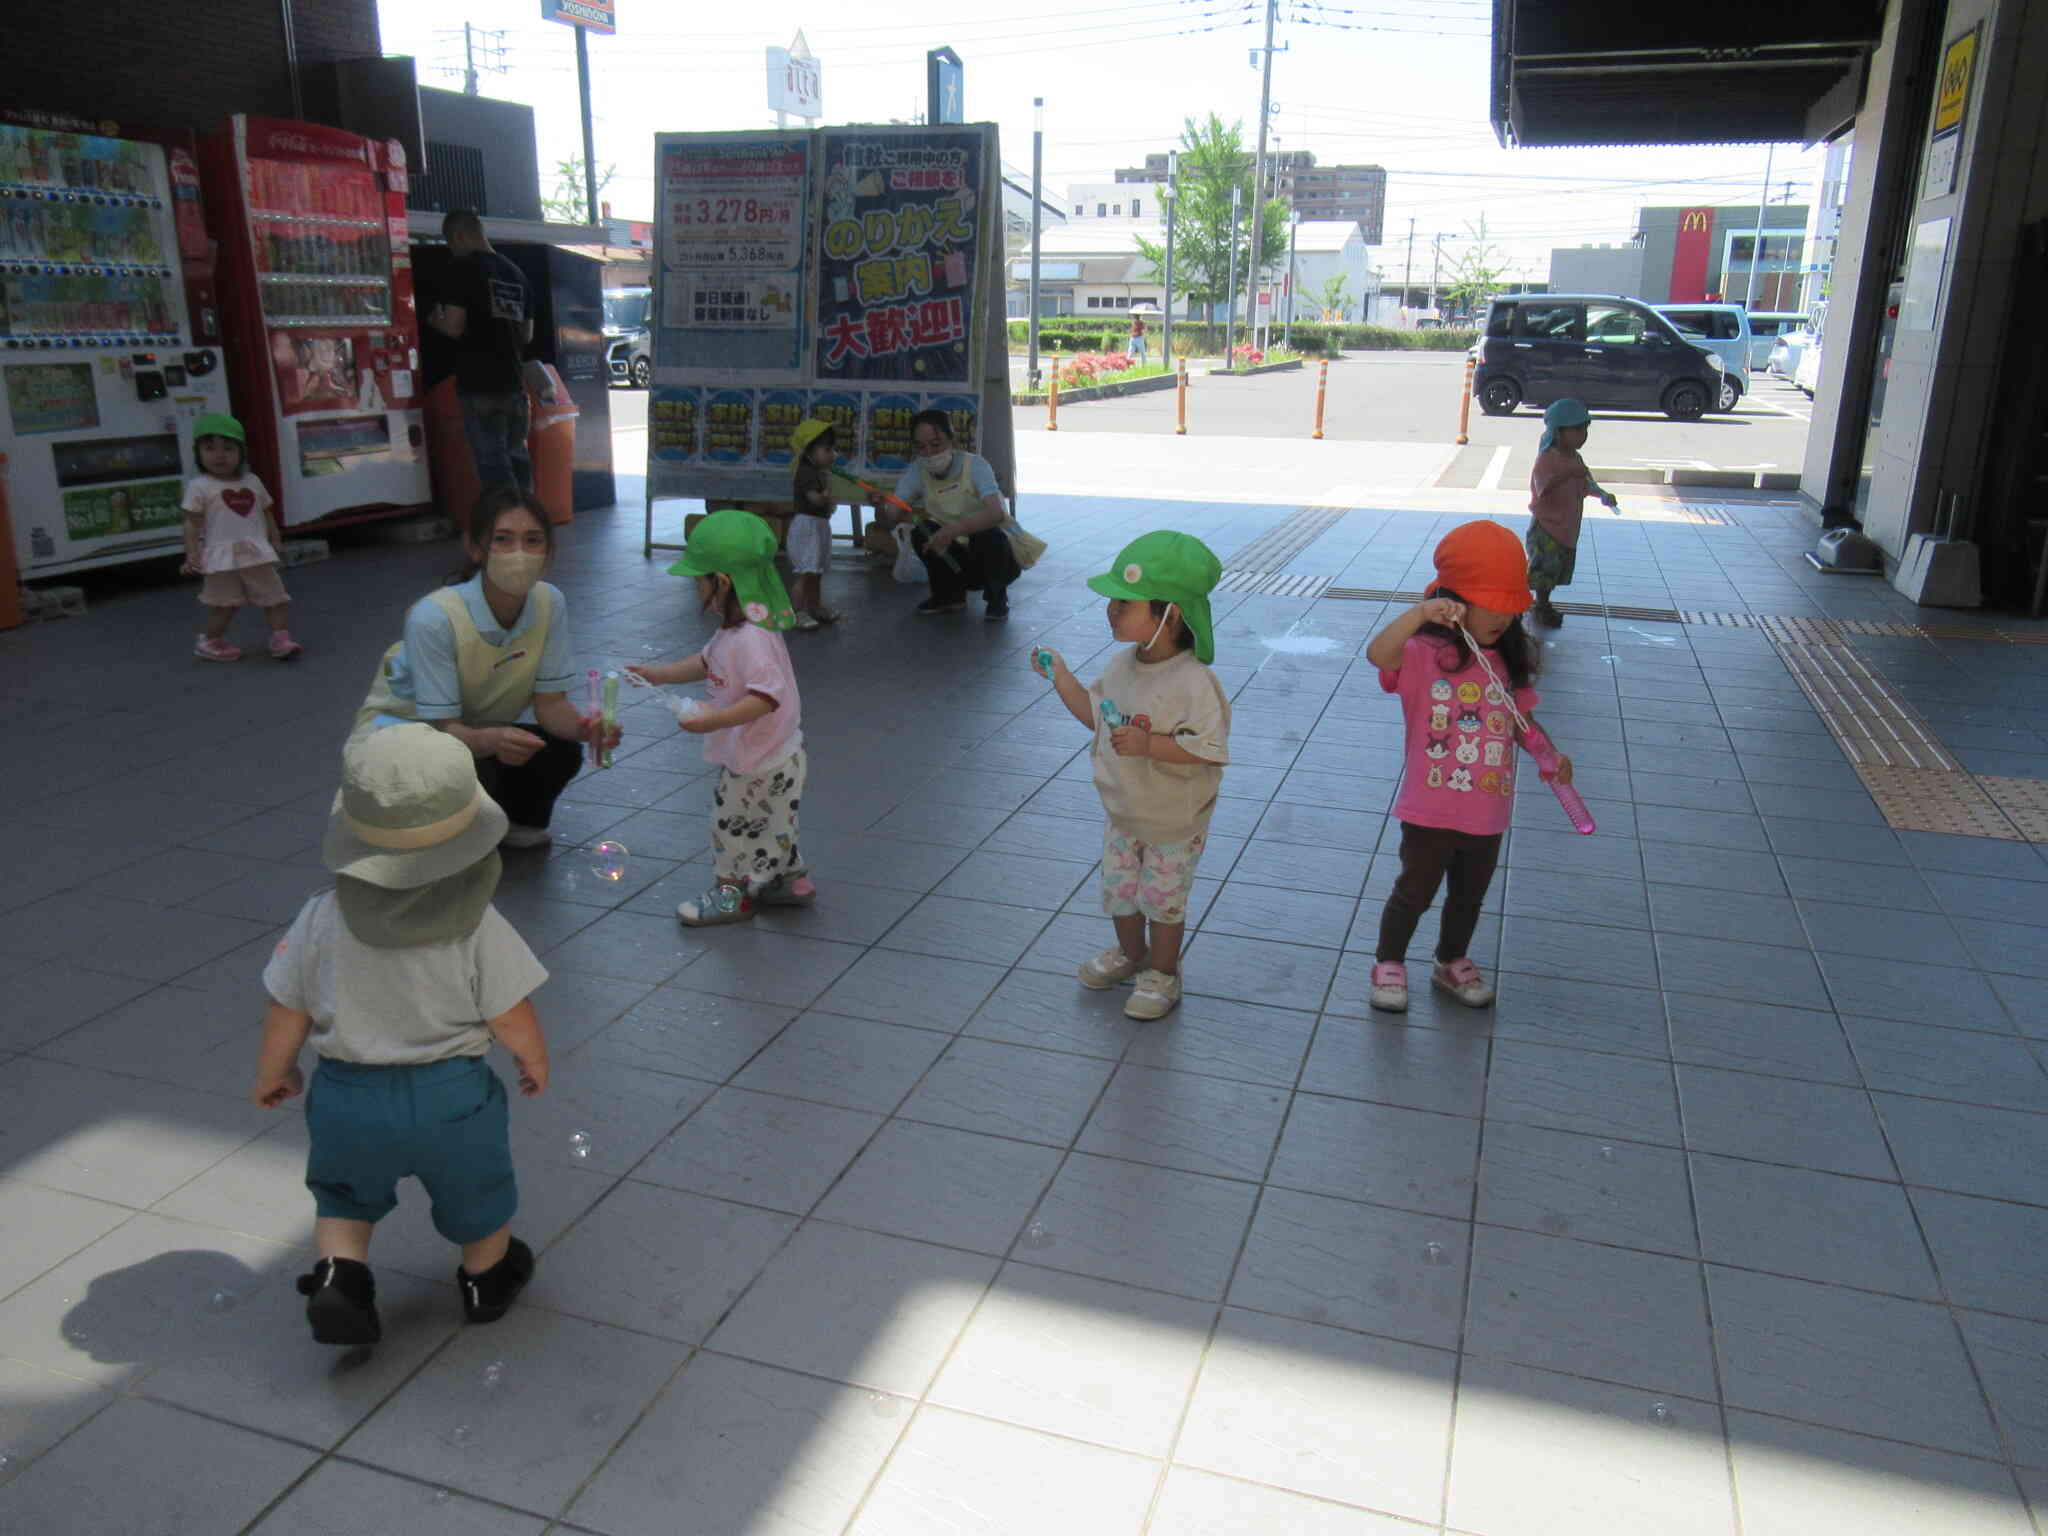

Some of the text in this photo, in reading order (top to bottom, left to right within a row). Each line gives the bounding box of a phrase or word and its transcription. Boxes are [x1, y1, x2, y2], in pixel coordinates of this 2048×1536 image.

[825, 199, 971, 257] のりかえ
[856, 255, 931, 302] 案内
[826, 299, 963, 362] 大歓迎!
